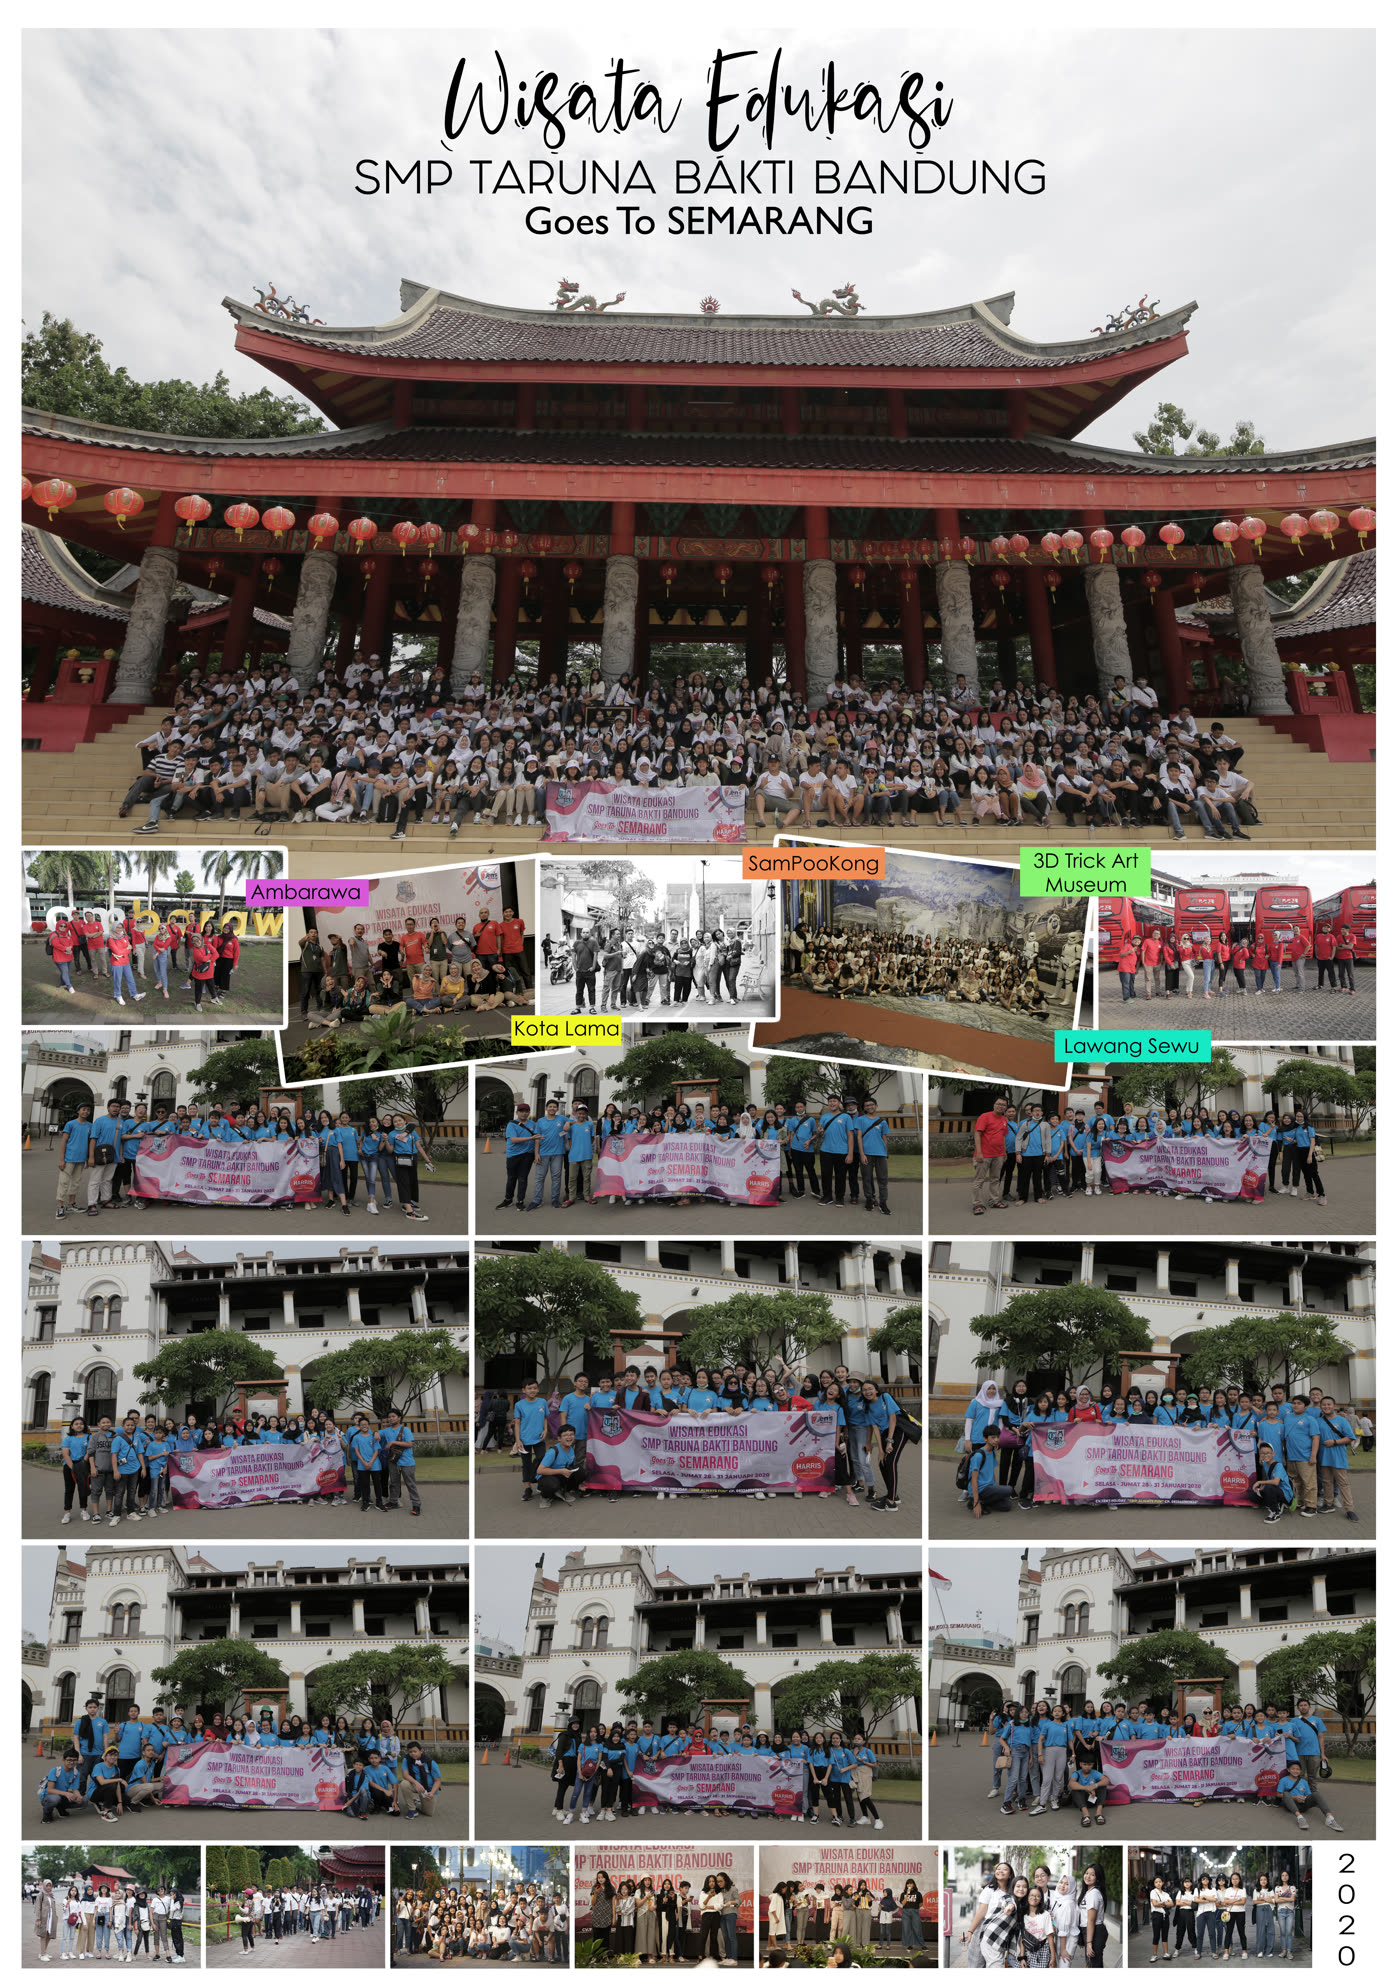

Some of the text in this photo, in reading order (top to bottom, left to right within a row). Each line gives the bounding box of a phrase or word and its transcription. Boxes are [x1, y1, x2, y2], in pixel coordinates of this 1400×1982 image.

[613, 793, 675, 808] WISATA EDUKASI
[587, 804, 699, 820] SMP TARUNA BAKTI BANDUNG
[618, 821, 667, 835] SEMARANG
[376, 903, 441, 920] WISATA EDUKASI
[373, 920, 403, 933] TARUNA
[205, 1148, 231, 1160] WISATA
[658, 1153, 683, 1162] TARUNA
[182, 1156, 279, 1172] SMP TARUNA BAKTI BANDUNG
[1176, 1156, 1196, 1166] BAKTI
[1197, 1156, 1229, 1166] BANDUNG
[208, 1172, 251, 1185] SEMARANG
[669, 1425, 748, 1438] WISATA EDUKASI
[642, 1437, 778, 1452] SMP TARUNA BAKTI BANDUNG
[1112, 1436, 1182, 1449] WISATA EDUKASI
[231, 1453, 284, 1464] WISATA EDUKASI
[1086, 1448, 1207, 1463] SMP TARUNA BAKTI BANDUNG
[211, 1461, 304, 1478] SMP TARUNA BAKTI BANDUNG
[679, 1456, 739, 1470] SEMARANG
[796, 1462, 821, 1470] HARRIS
[1120, 1464, 1174, 1478] SEMARANG
[239, 1473, 279, 1487] SEMARANG
[230, 1752, 283, 1765] WISATA EDUKASI
[1164, 1746, 1221, 1758] WISATA EDUKASI
[690, 1763, 742, 1771] WISATA EDUKASI
[1143, 1756, 1243, 1769] SMP TARUNA BAKTI BANDUNG
[207, 1762, 304, 1777] SMP TARUNA BAKTI BANDUNG
[1172, 1769, 1215, 1782] SEMARANG
[234, 1776, 277, 1789] SEMARANG
[671, 1773, 762, 1782] SMP TARUNA BAKTI BANDUNG
[696, 1782, 736, 1793] SEMARANG
[590, 1854, 635, 1869] TARUNA
[638, 1853, 673, 1868] BAKTI
[675, 1852, 733, 1868] BANDUNG
[821, 1849, 894, 1860] WISATA EDUKASI
[793, 1862, 922, 1874] SMP TARUNA BAKTI BANDUNG
